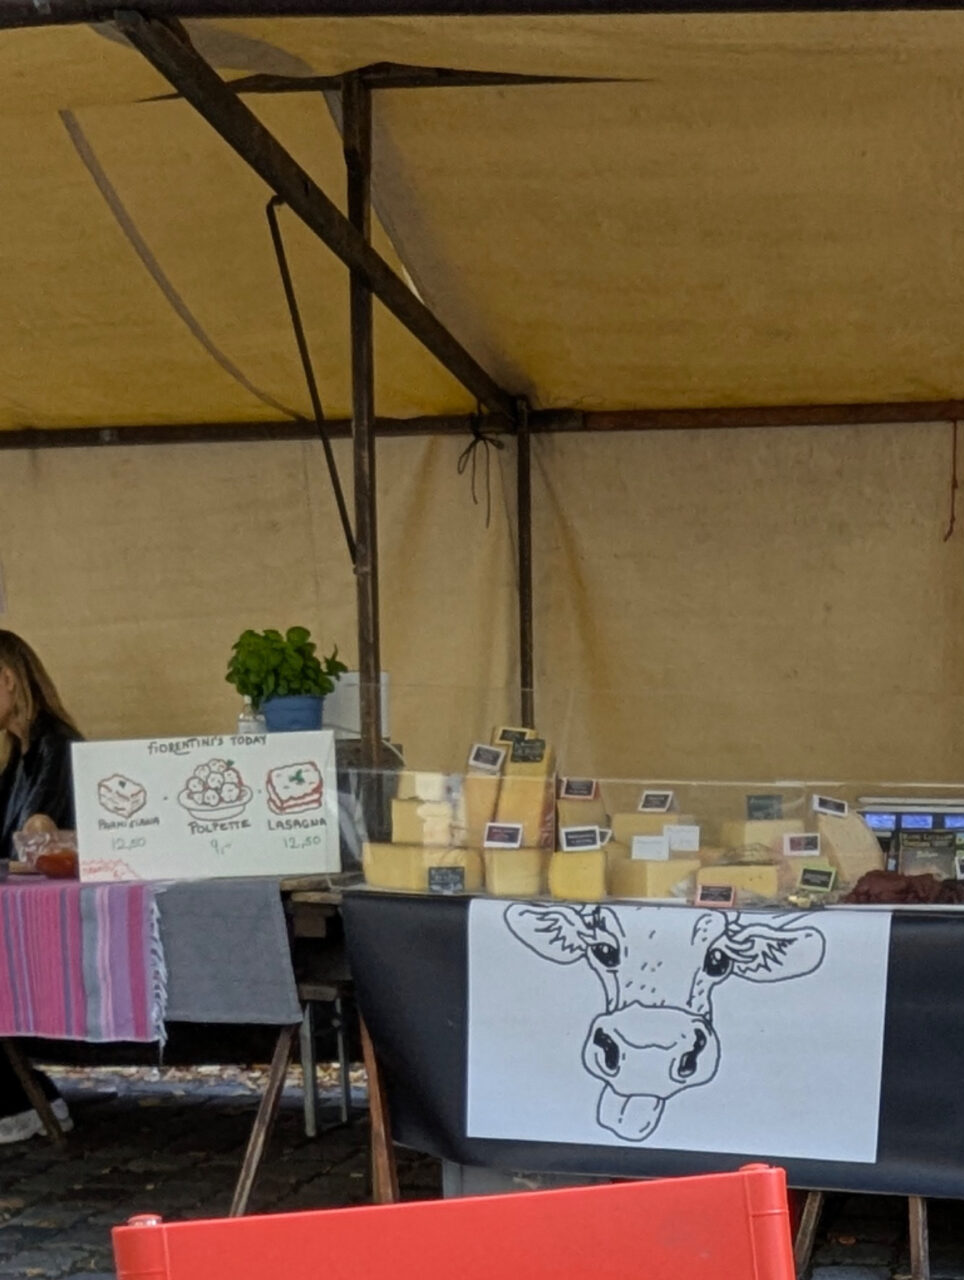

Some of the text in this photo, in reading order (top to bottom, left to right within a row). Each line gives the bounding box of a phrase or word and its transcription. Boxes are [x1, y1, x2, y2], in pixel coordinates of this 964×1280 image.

[230, 735, 267, 746] TODAY
[188, 819, 251, 835] POLPETTE
[267, 818, 327, 831] LASAGNA
[283, 836, 321, 850] 12,50
